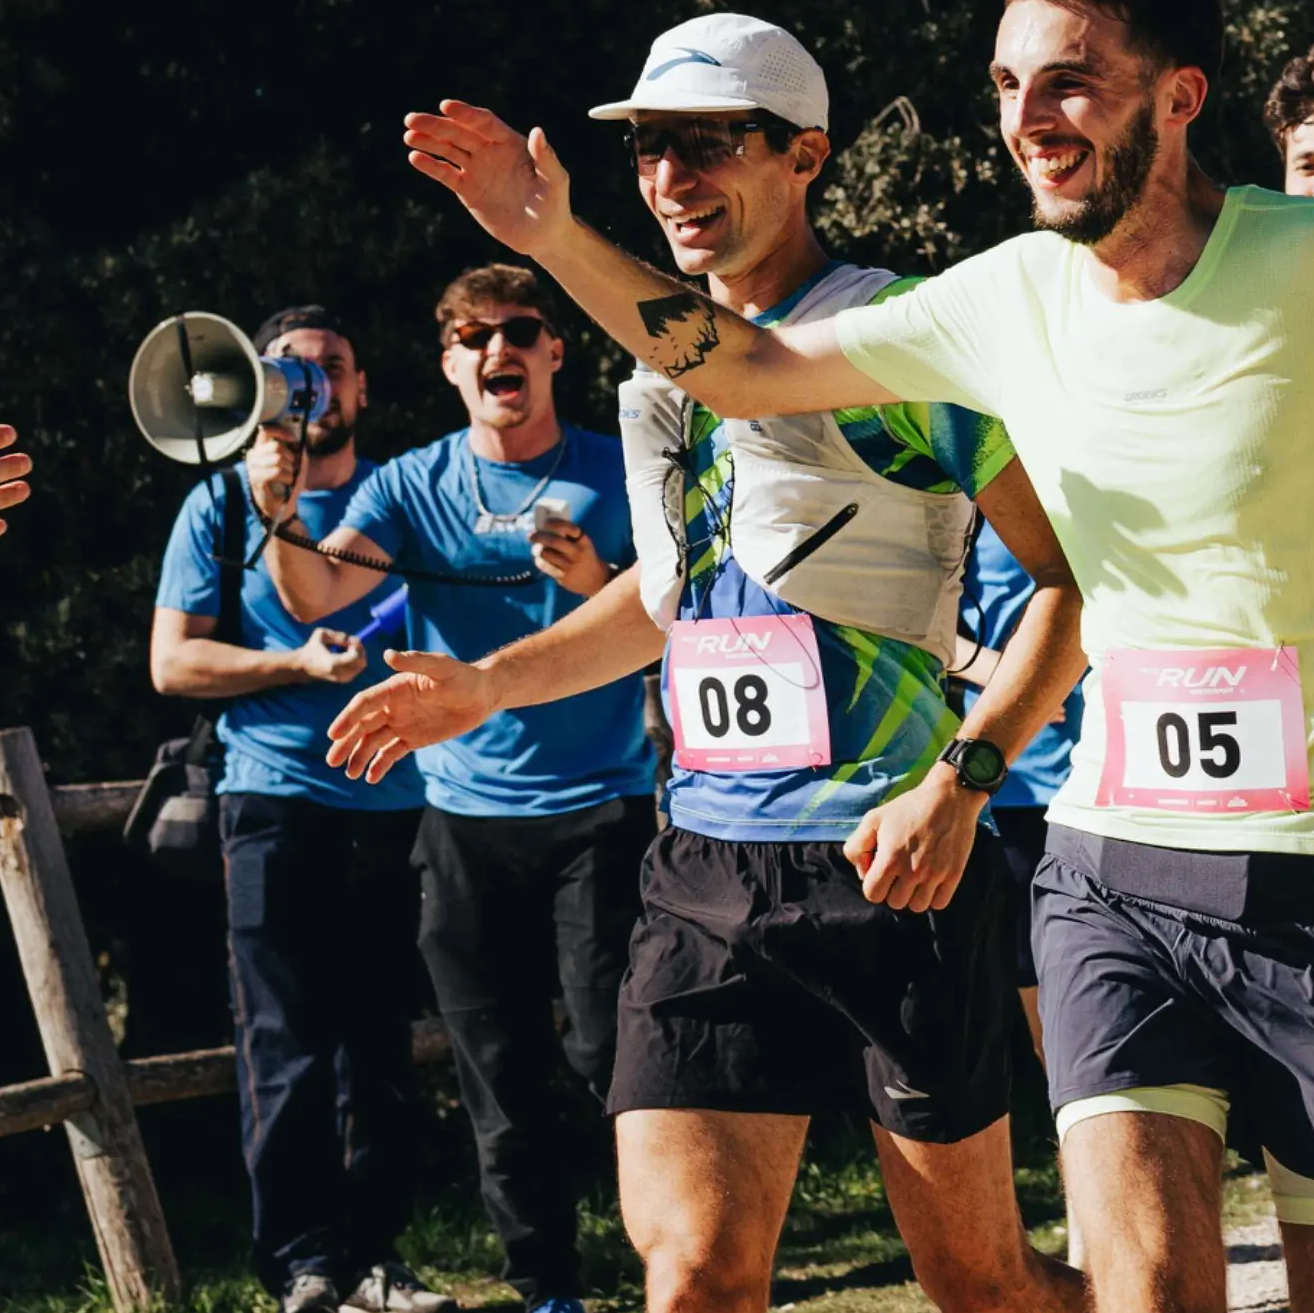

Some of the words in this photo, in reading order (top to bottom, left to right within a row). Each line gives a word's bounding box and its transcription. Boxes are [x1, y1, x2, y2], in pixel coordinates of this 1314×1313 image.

[697, 632, 772, 655] RUN
[1155, 666, 1247, 687] RUN
[699, 673, 772, 738] 08
[1156, 711, 1241, 779] 05
